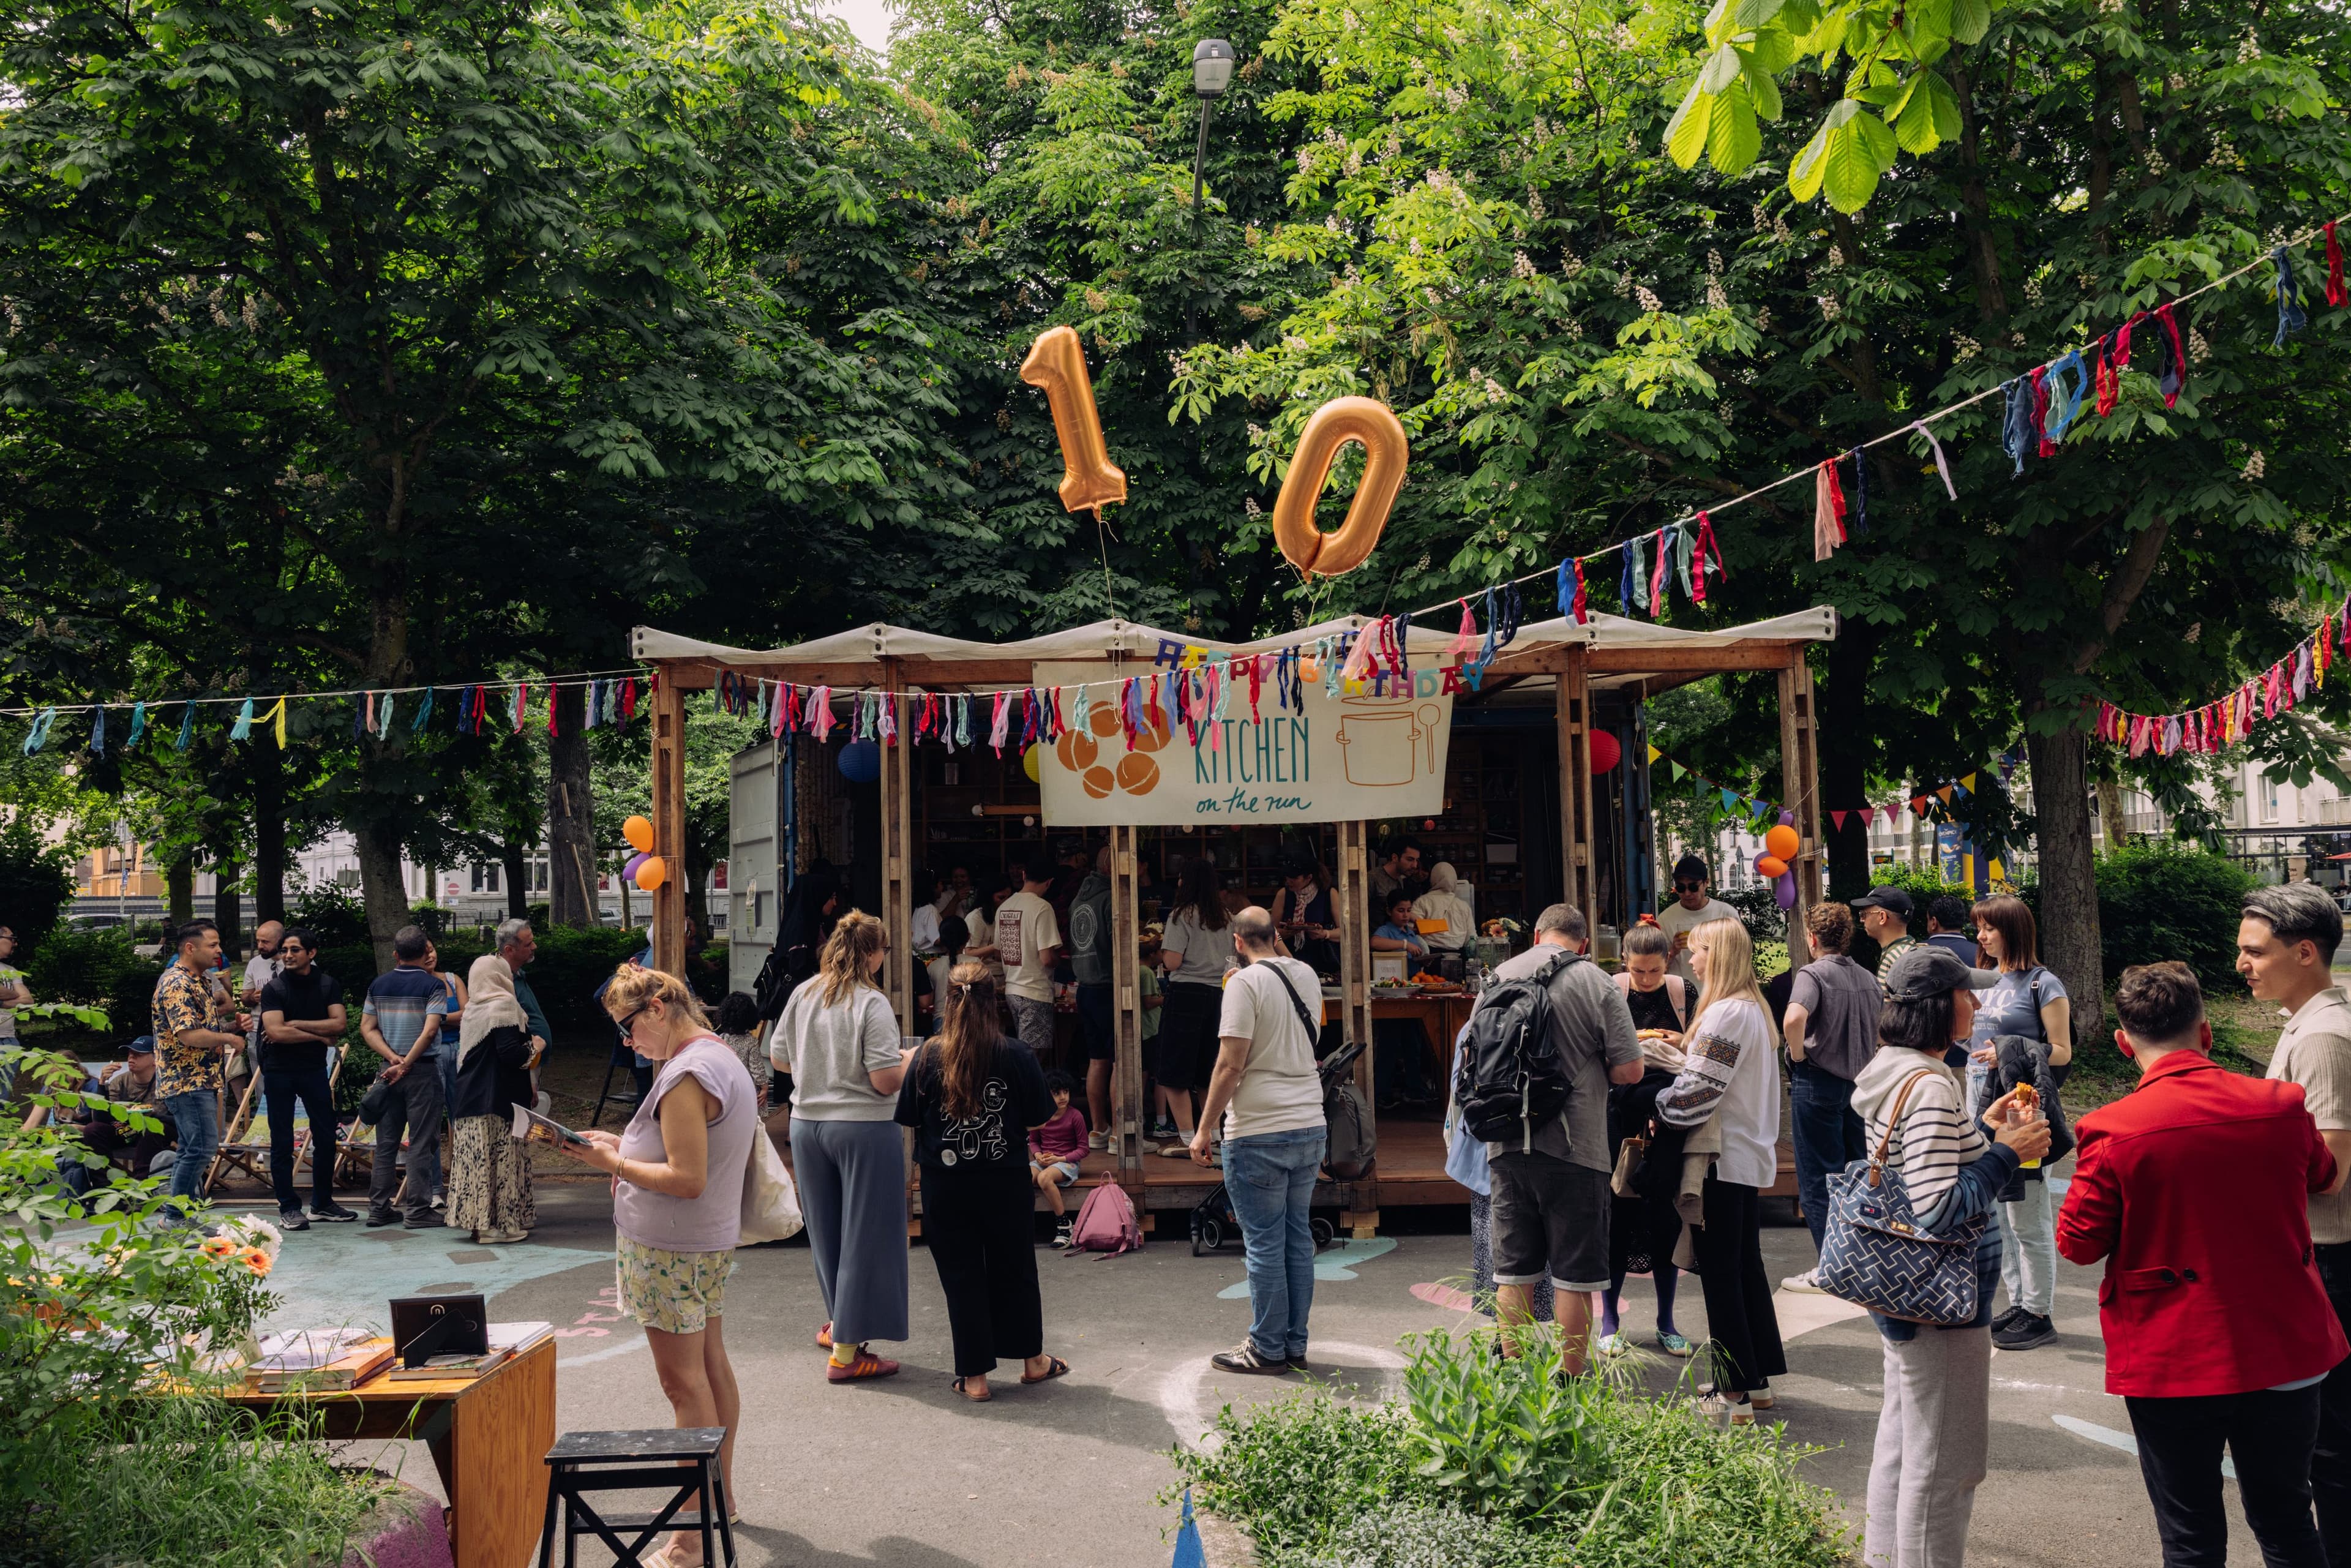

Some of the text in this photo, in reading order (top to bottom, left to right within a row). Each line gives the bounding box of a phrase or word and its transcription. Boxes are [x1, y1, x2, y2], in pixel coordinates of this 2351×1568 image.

[1196, 786, 1312, 814] on the run
